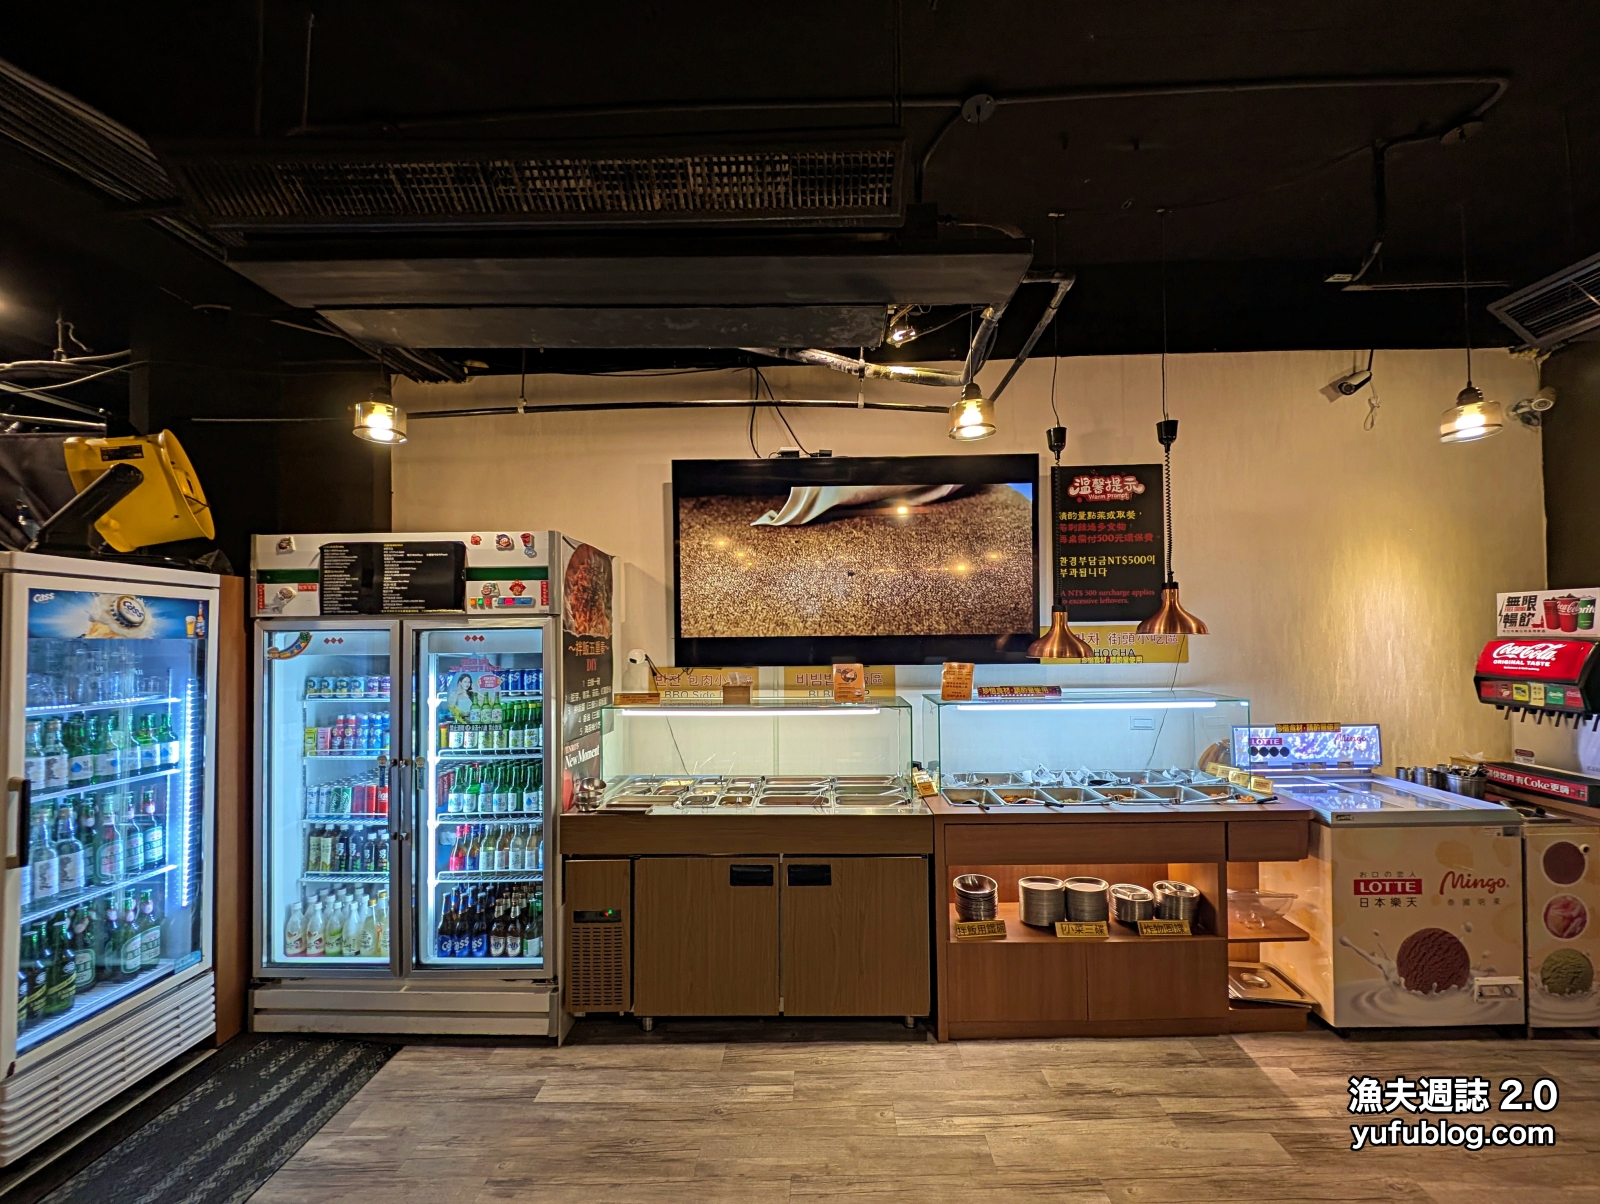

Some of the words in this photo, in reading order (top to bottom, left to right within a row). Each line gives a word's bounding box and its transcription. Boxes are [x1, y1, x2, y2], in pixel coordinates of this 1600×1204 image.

[1074, 476, 1137, 495] 溫馨提示
[1059, 567, 1108, 577] 부과됩니다
[33, 592, 55, 603] Cass
[1098, 589, 1130, 598] surcharge
[1131, 589, 1155, 598] applies
[122, 600, 144, 619] Cass
[1506, 594, 1538, 612] 無限
[1503, 612, 1536, 628] 暢飲
[1492, 642, 1567, 661] Coca-Cola
[586, 659, 597, 672] DIY
[1359, 881, 1417, 893] LOTTE
[1439, 870, 1507, 895] Mingo
[1359, 896, 1418, 908] 日本樂天
